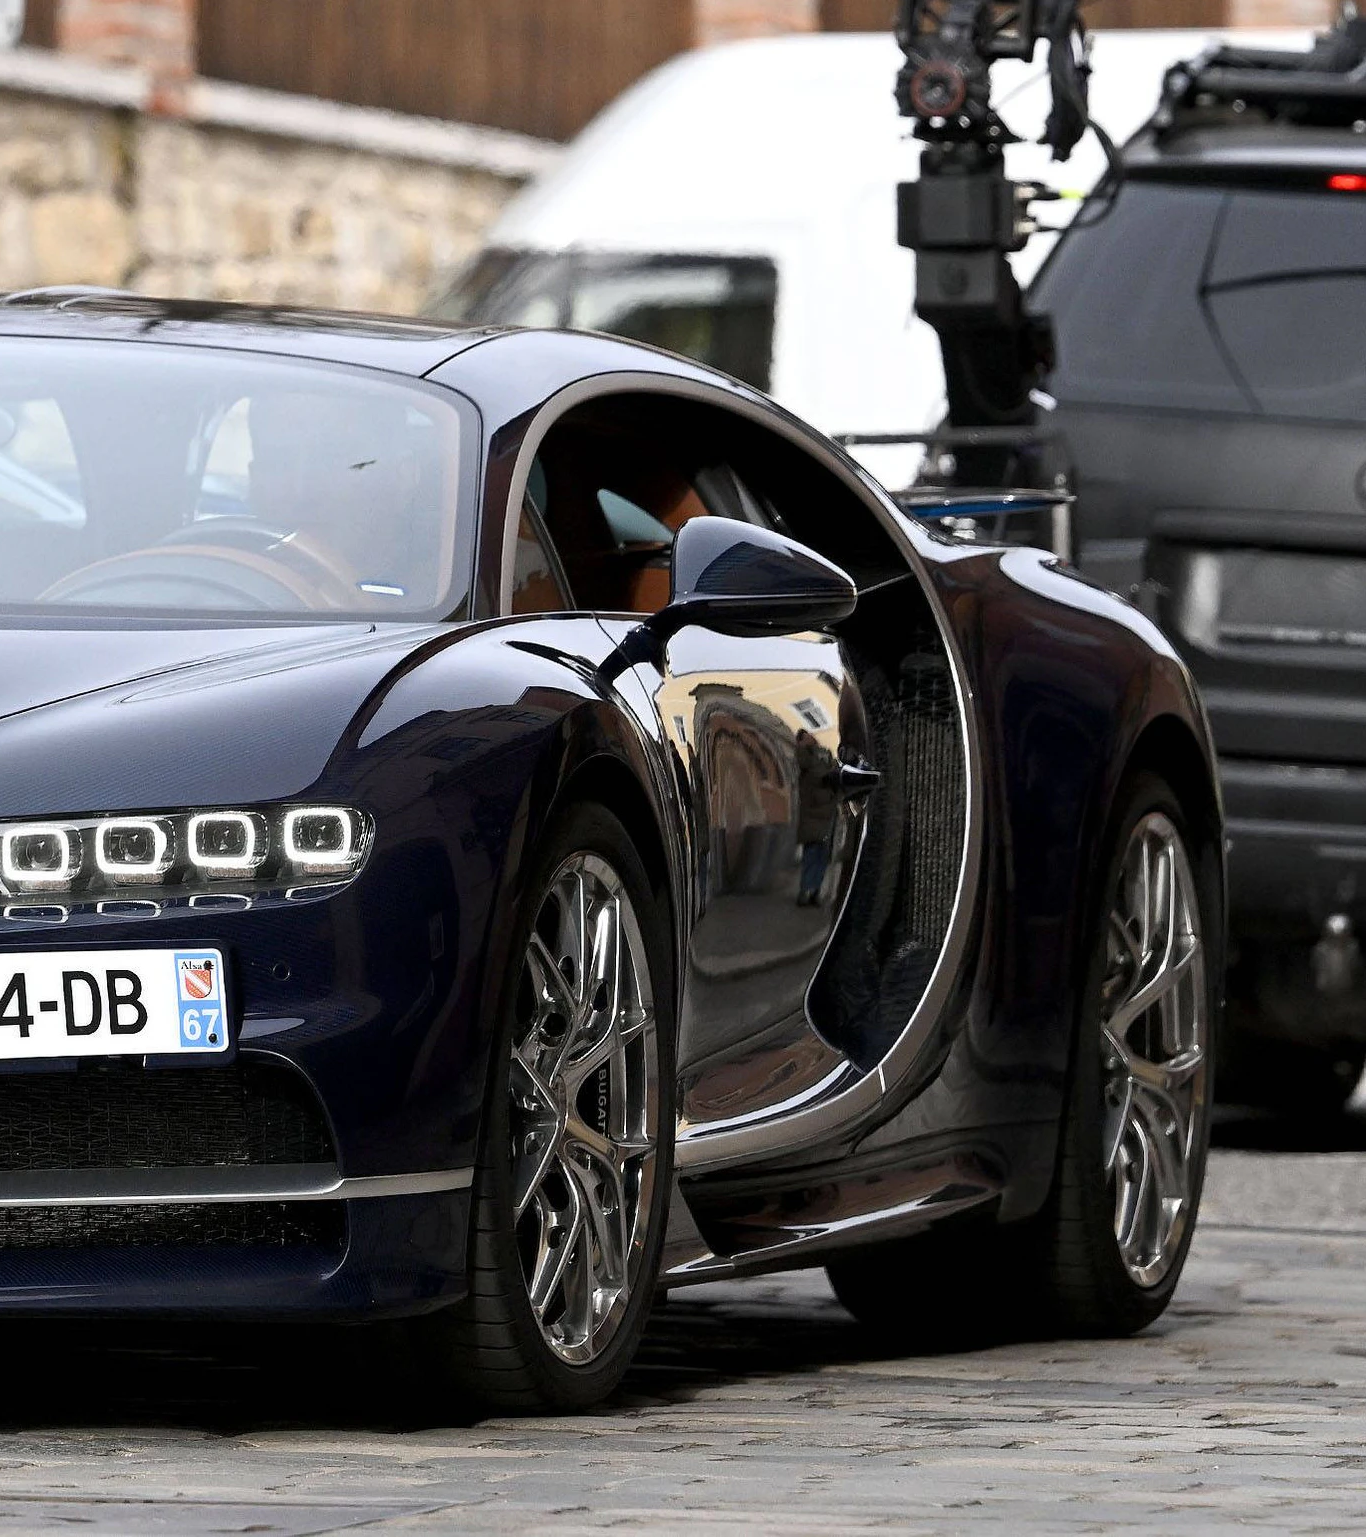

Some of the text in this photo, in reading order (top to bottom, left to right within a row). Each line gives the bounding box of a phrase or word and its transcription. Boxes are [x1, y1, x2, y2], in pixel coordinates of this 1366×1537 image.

[181, 960, 214, 970] Alsa
[183, 1008, 219, 1041] 67
[598, 1069, 607, 1136] BUGAT
